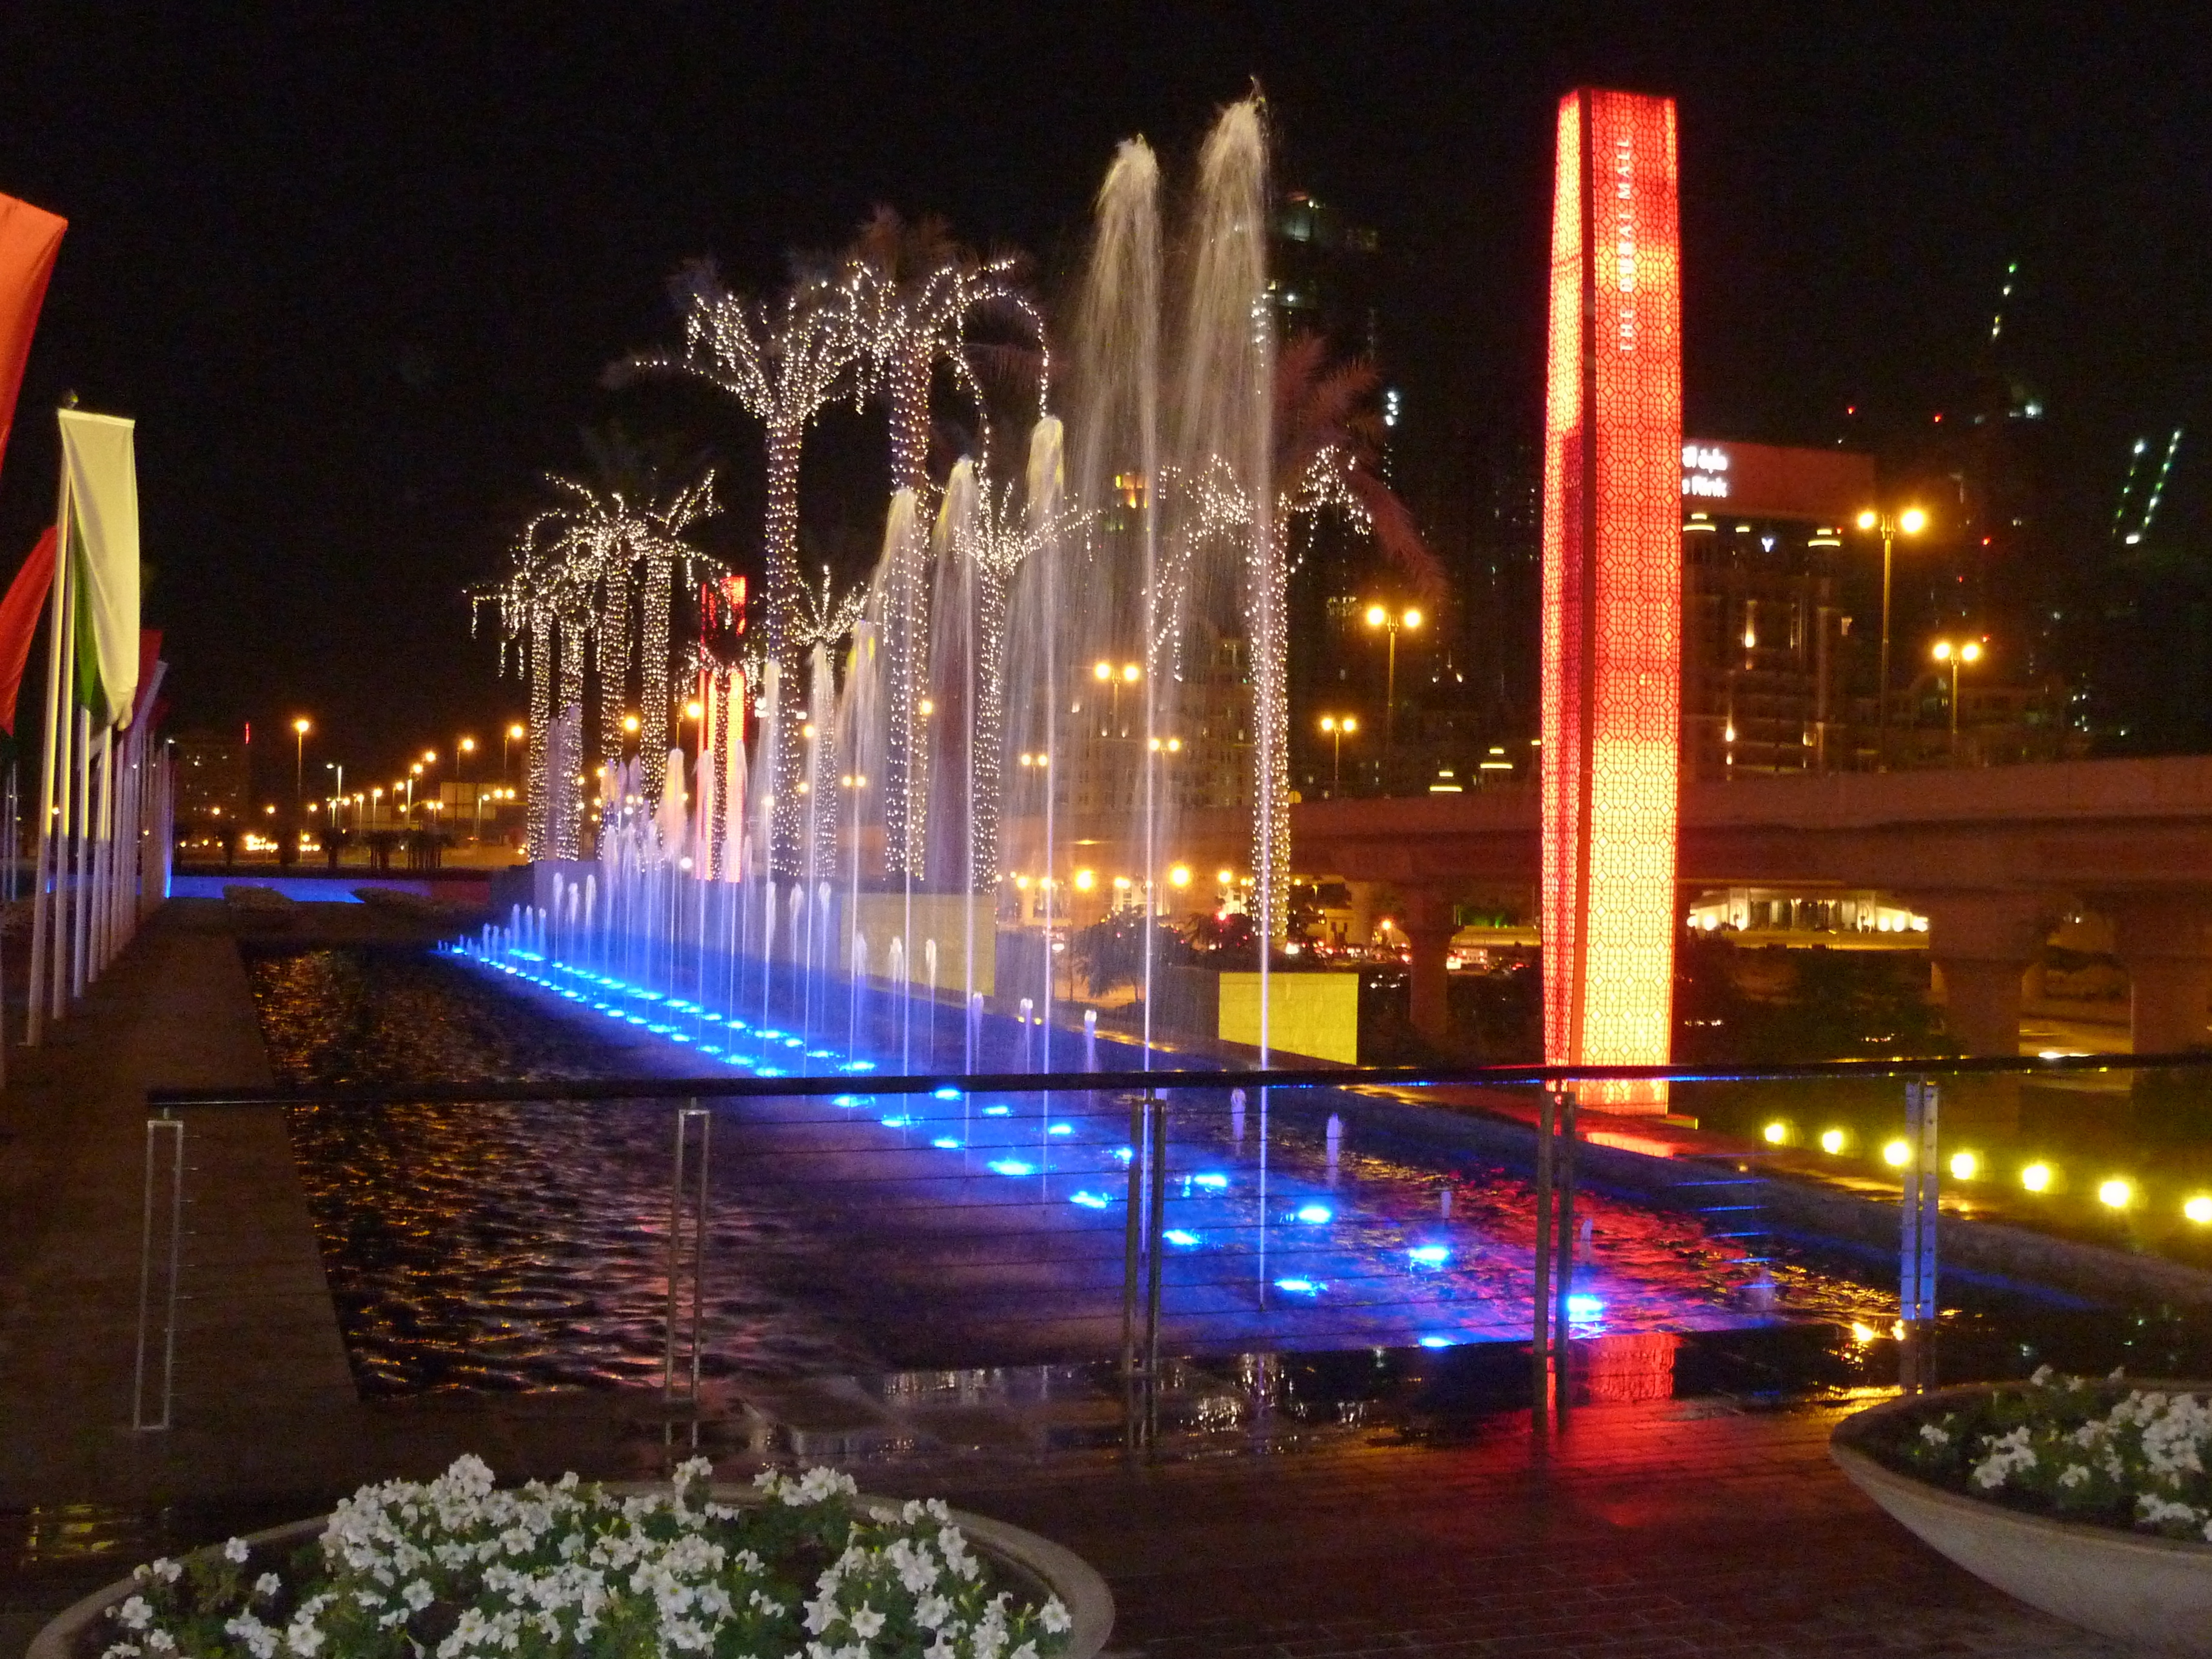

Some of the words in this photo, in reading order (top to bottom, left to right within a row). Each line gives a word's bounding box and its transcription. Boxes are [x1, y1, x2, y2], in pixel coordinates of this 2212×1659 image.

[1617, 139, 1631, 199] MALL
[1618, 213, 1633, 292] DUBAI
[1620, 309, 1633, 353] THE
